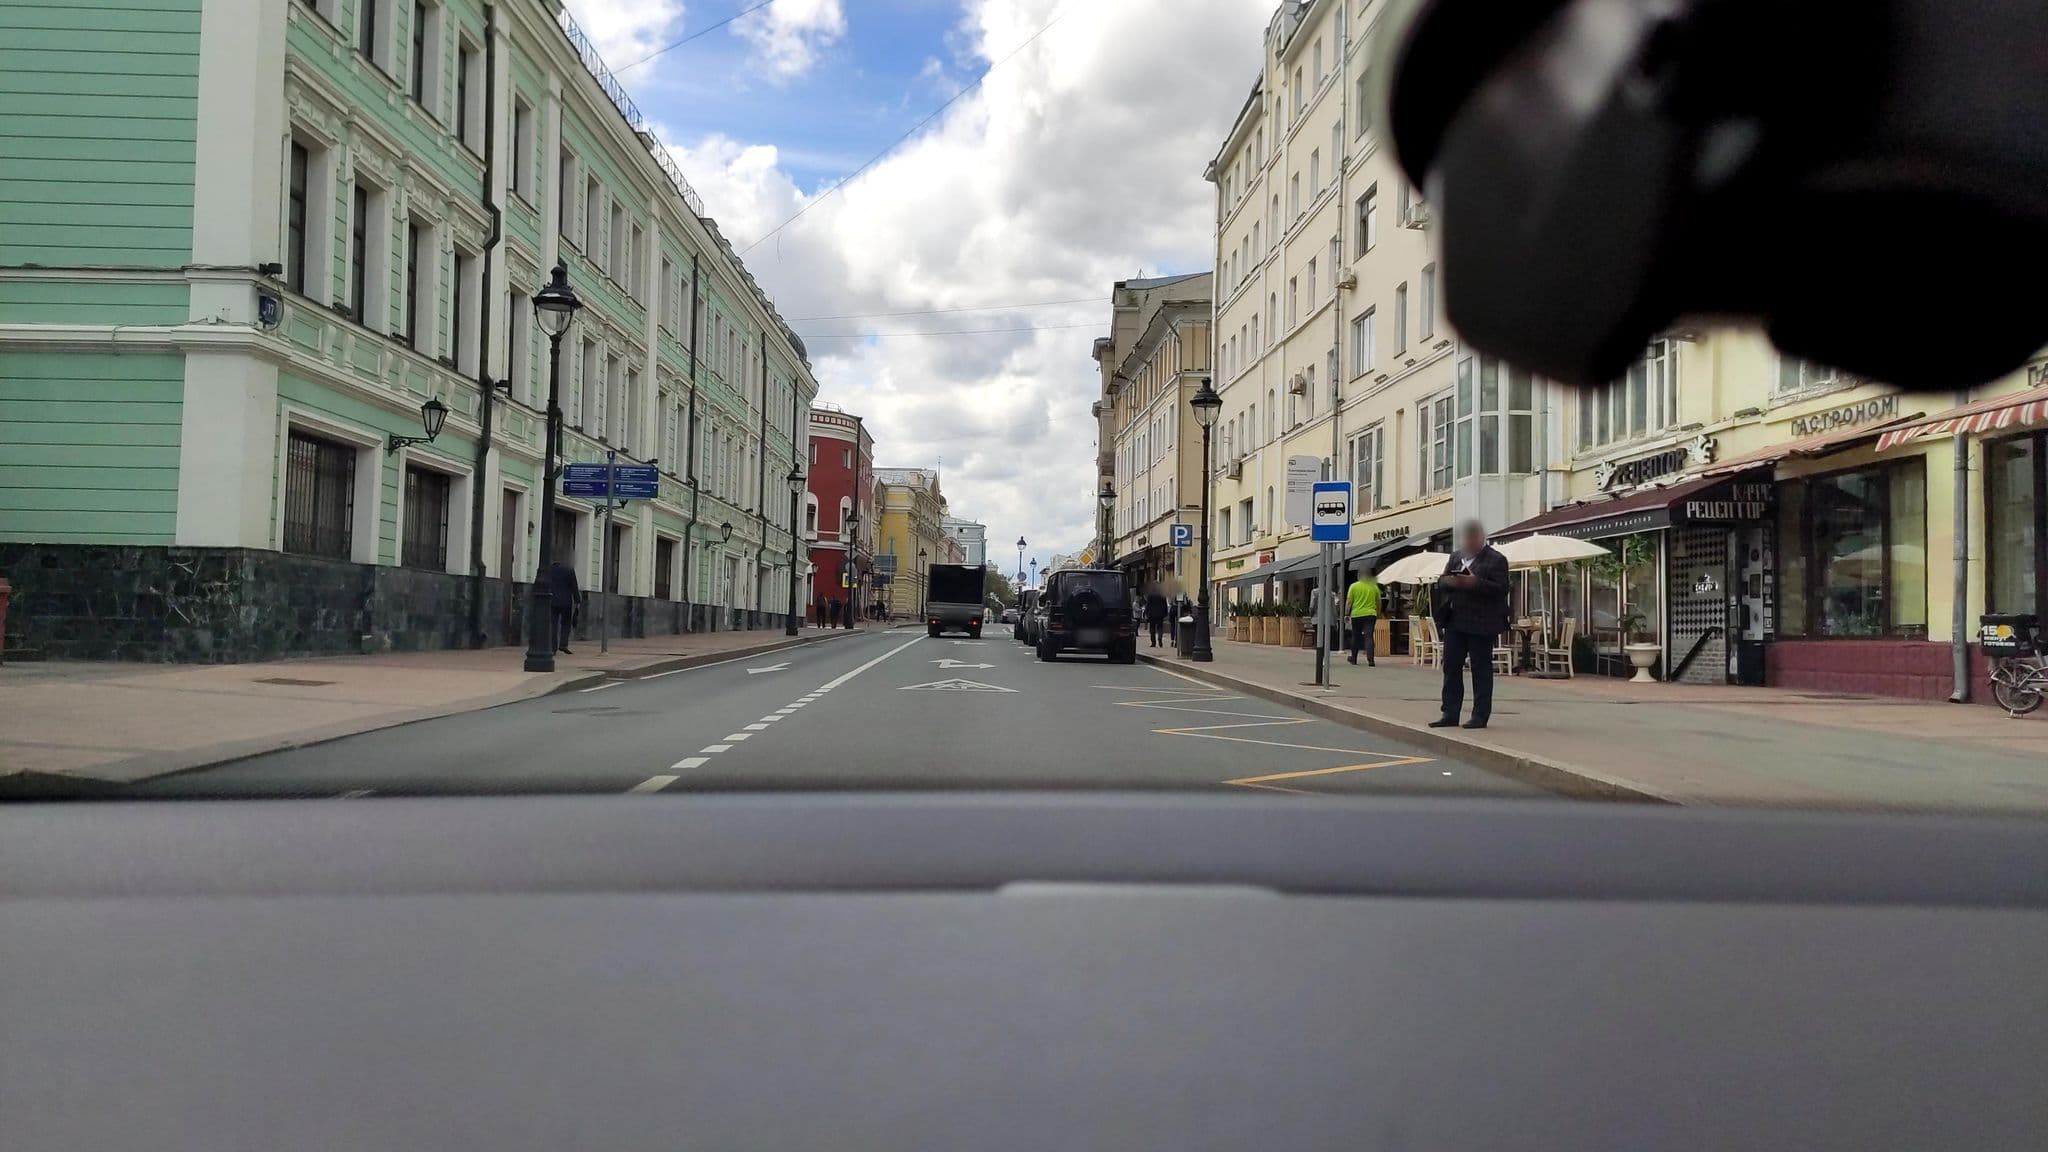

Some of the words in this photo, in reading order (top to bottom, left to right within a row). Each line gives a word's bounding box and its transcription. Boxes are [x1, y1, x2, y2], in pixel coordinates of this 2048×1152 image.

[1790, 395, 1894, 436] ГАСТРОНОМ
[1615, 447, 1688, 486] РЕЦЕПТОР
[1373, 525, 1410, 541] РЕСТОРАН
